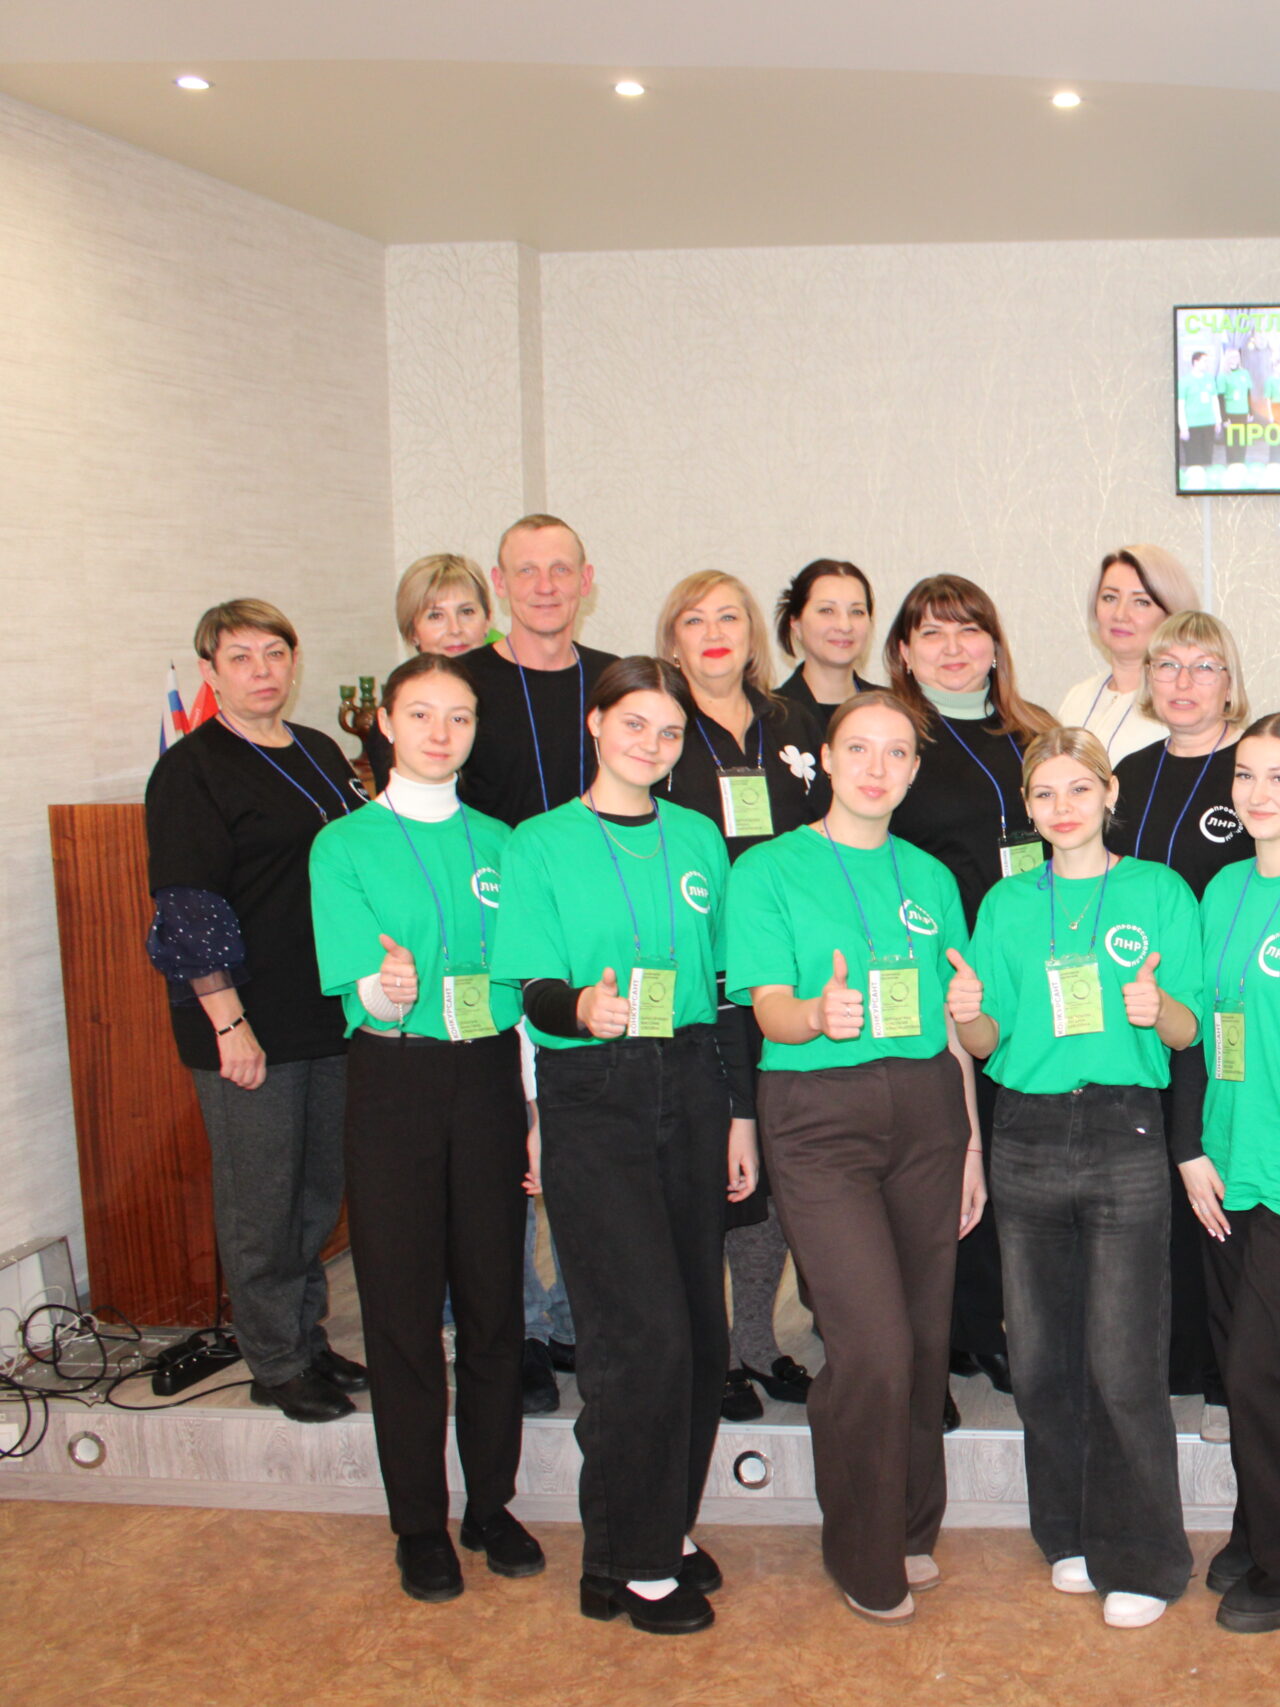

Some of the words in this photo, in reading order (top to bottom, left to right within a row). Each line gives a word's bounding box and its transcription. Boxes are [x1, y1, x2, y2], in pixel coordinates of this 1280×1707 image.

[1207, 816, 1236, 830] ЛНР
[480, 881, 501, 893] ЛН
[1113, 937, 1142, 953] ЛНР
[446, 987, 458, 1039] КОНКУРСАНТ
[631, 978, 642, 1035] КОНКУРСАНТ
[871, 982, 881, 1036] КОНКУРСАНТ
[1052, 981, 1064, 1035] КОНКУРСАНТ
